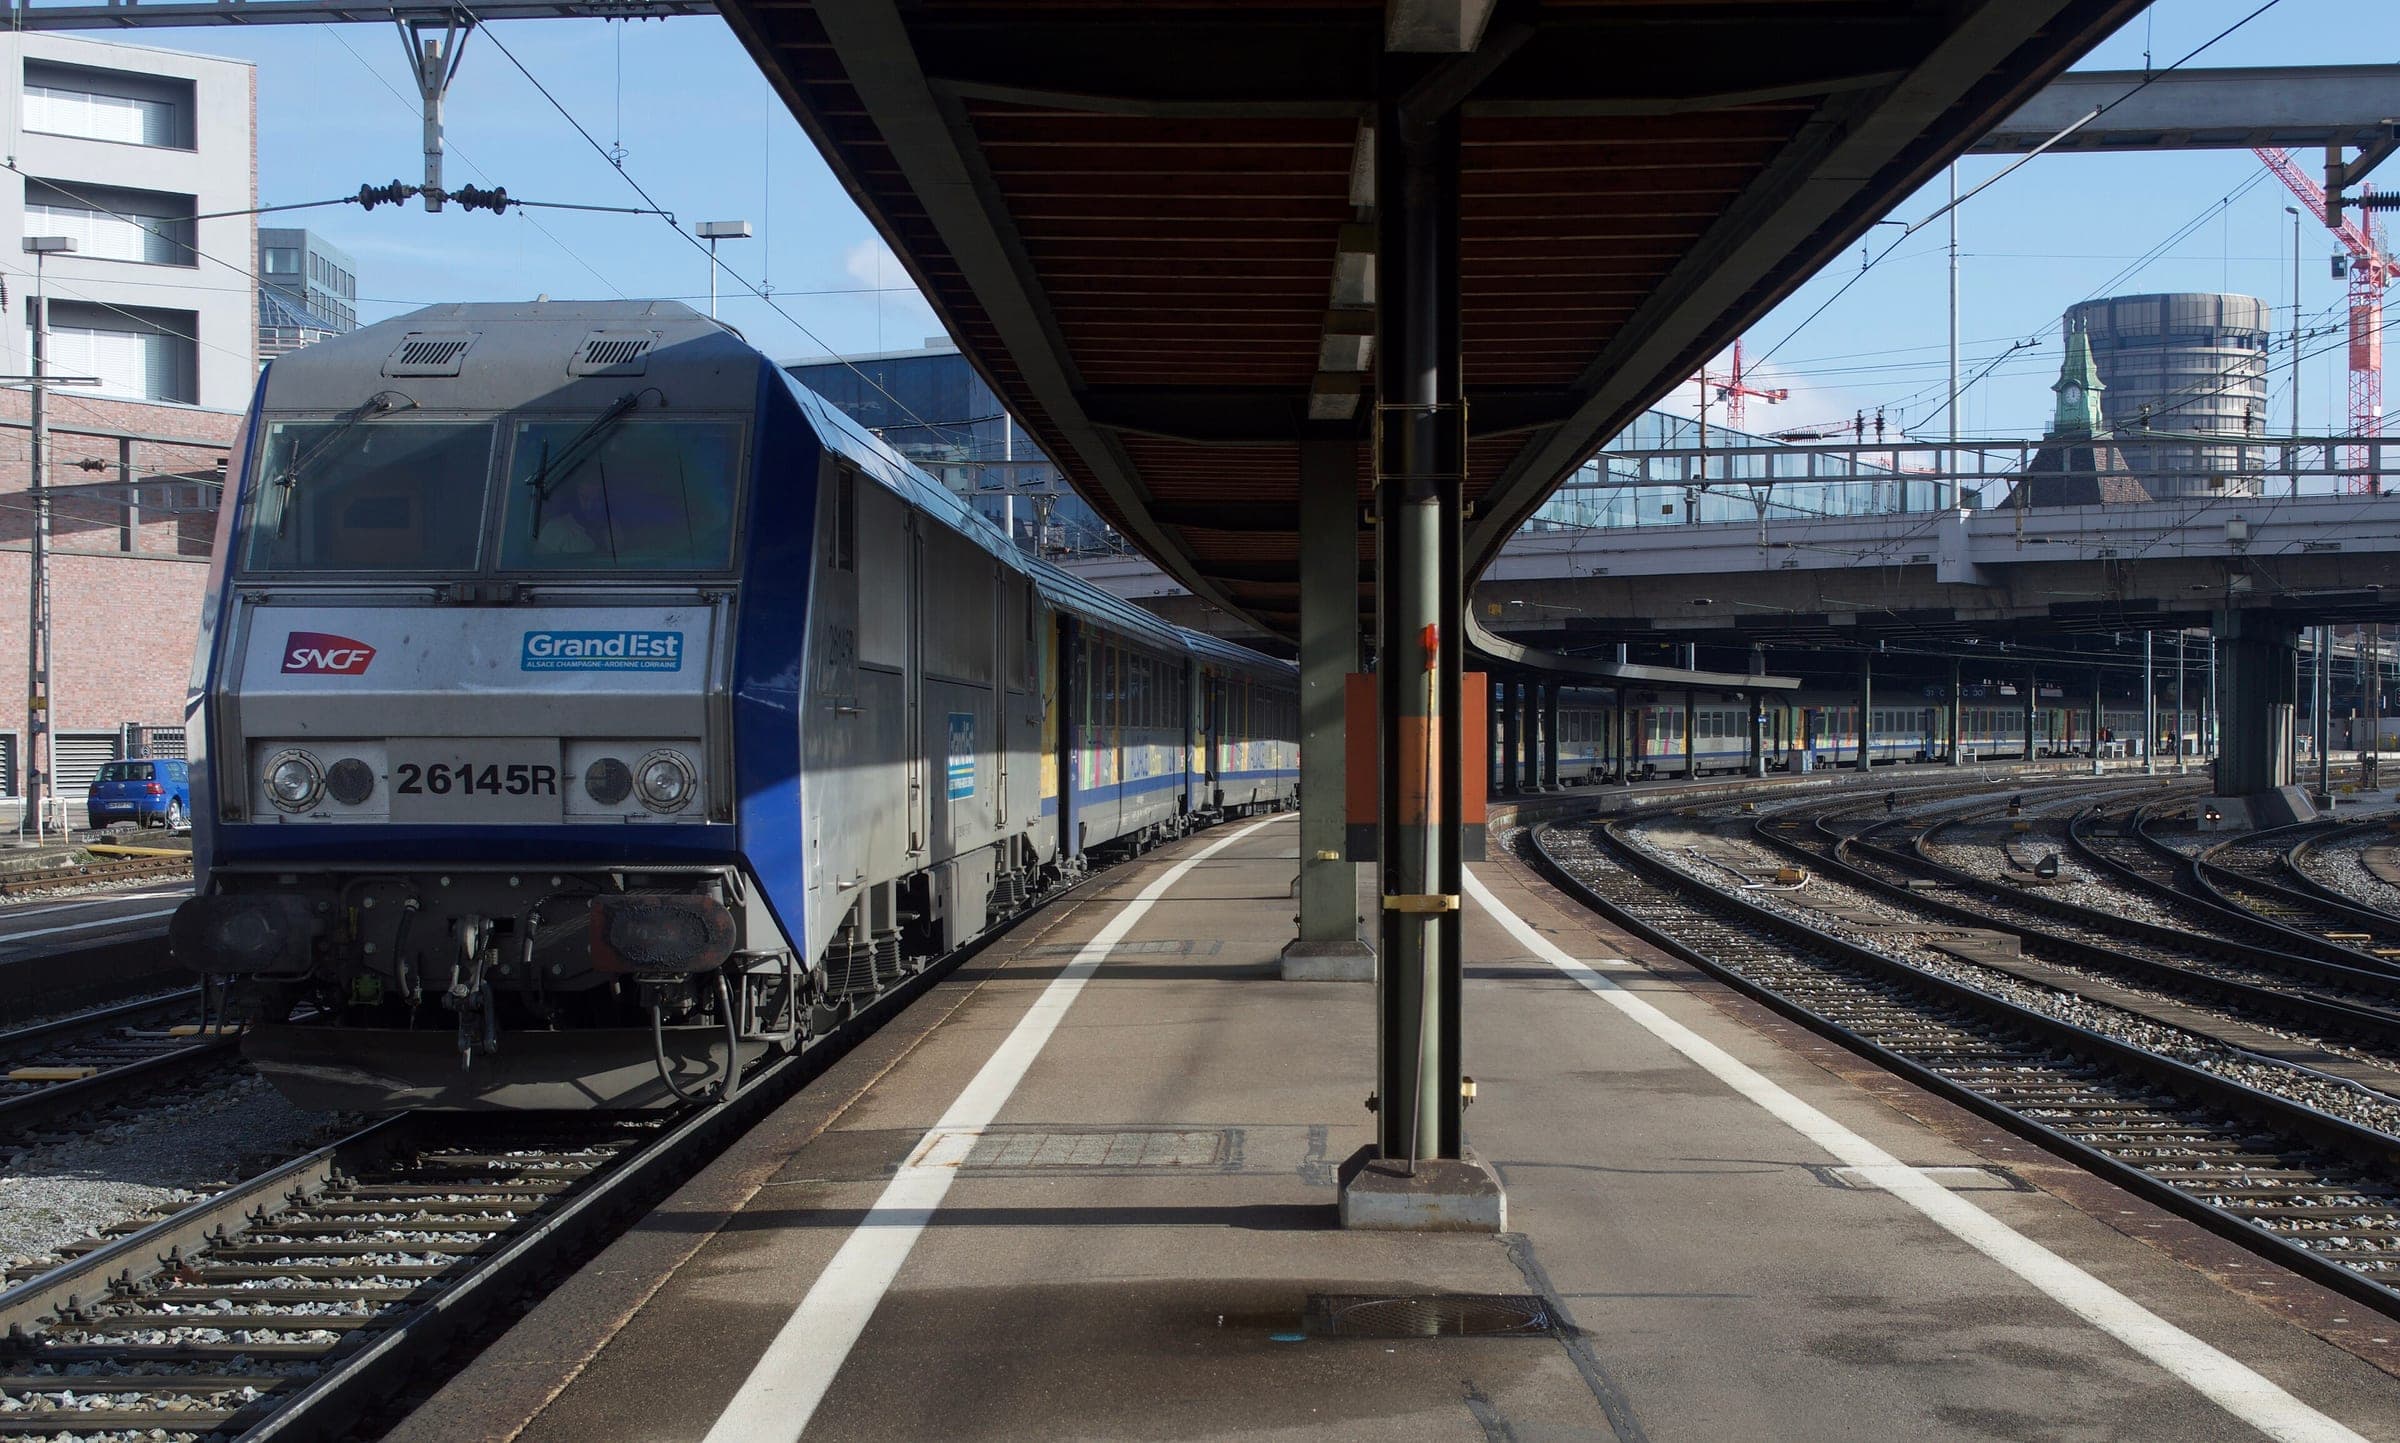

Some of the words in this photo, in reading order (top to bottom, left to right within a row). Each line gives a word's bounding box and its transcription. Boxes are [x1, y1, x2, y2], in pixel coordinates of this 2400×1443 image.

[286, 648, 370, 670] SNCF
[526, 660, 555, 668] ALSACE
[640, 661, 677, 669] LORRAINE
[397, 763, 557, 796] 26145R
